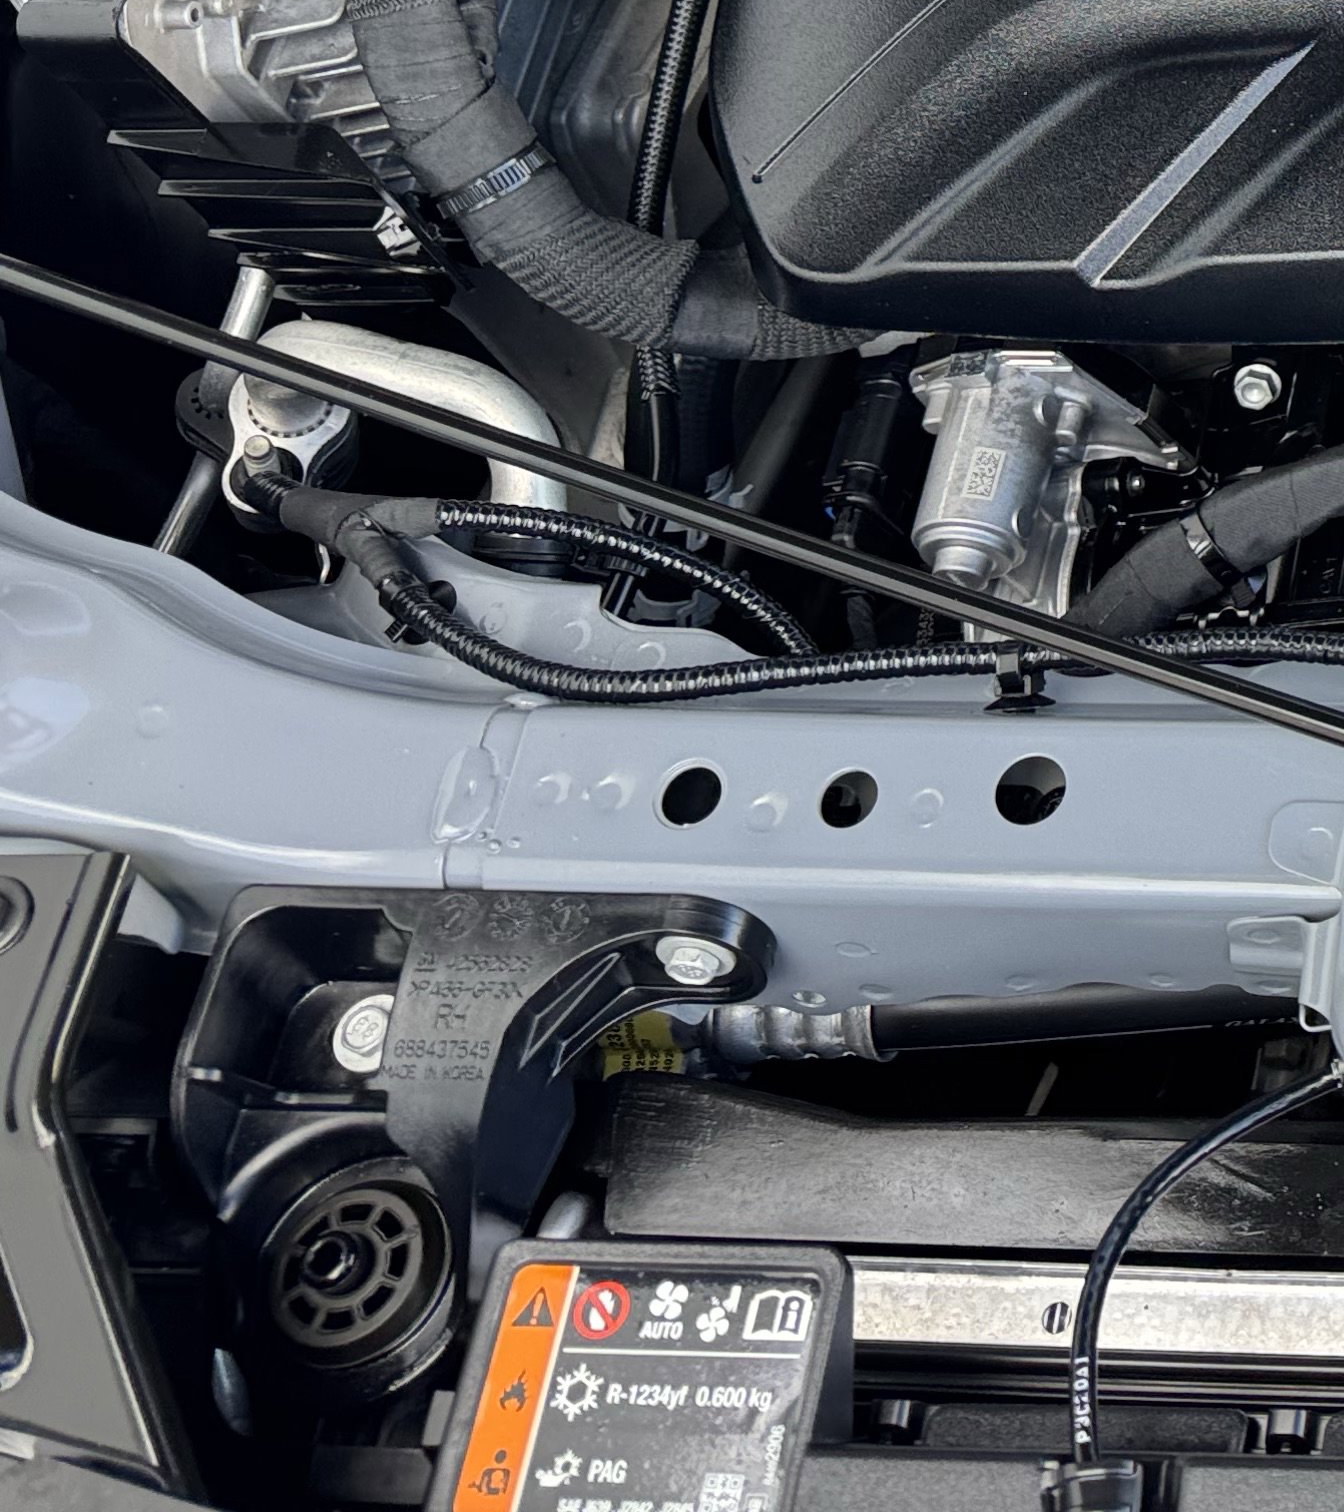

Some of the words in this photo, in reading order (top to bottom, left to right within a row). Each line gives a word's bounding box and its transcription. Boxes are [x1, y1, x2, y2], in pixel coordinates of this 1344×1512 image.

[434, 1003, 471, 1030] RH
[424, 1067, 437, 1080] IN
[639, 1321, 683, 1340] AUTO
[606, 1383, 689, 1411] R-1234yf
[695, 1388, 746, 1408] 0.600
[748, 1390, 772, 1413] kg
[587, 1459, 628, 1485] PAG
